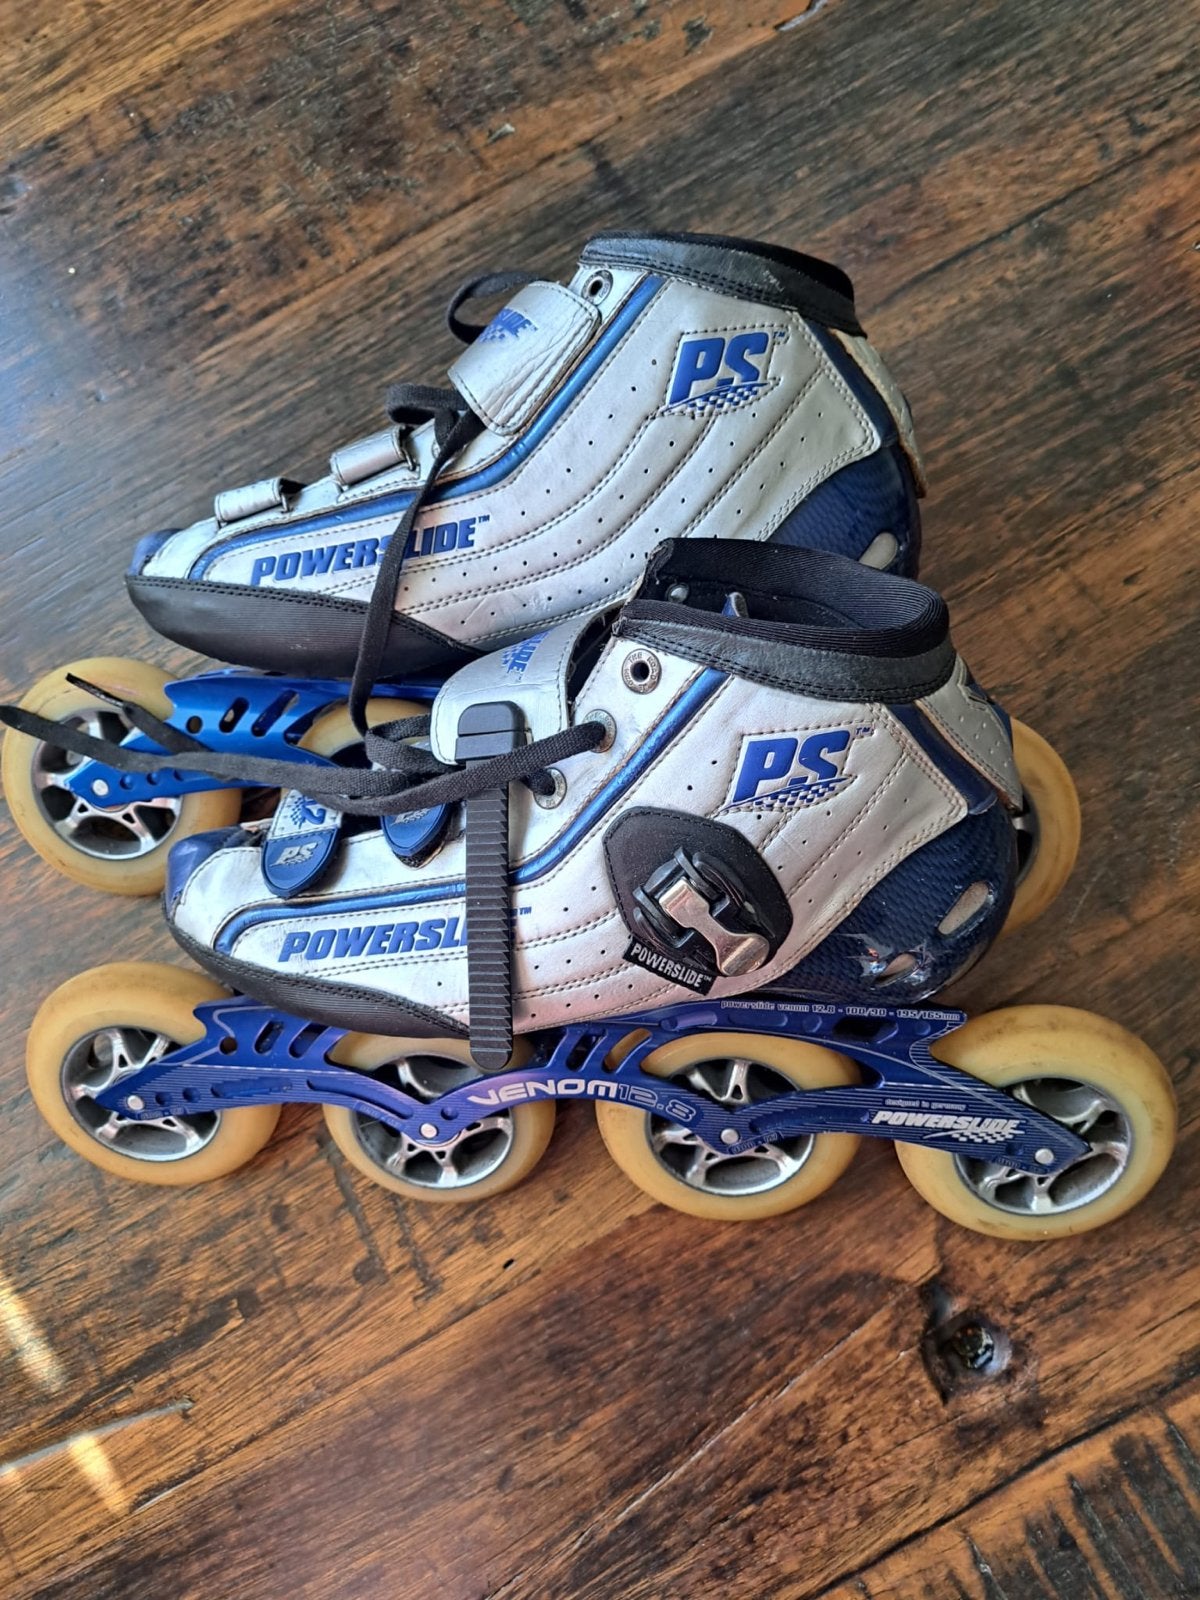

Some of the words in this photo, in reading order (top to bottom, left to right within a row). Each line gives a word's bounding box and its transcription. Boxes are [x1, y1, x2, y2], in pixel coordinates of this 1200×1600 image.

[720, 1000, 775, 1010] powerslide
[777, 1003, 809, 1012] venom
[812, 1004, 835, 1014] 12.8
[846, 1006, 887, 1017] 100/90
[896, 1009, 960, 1021] 195/165mm
